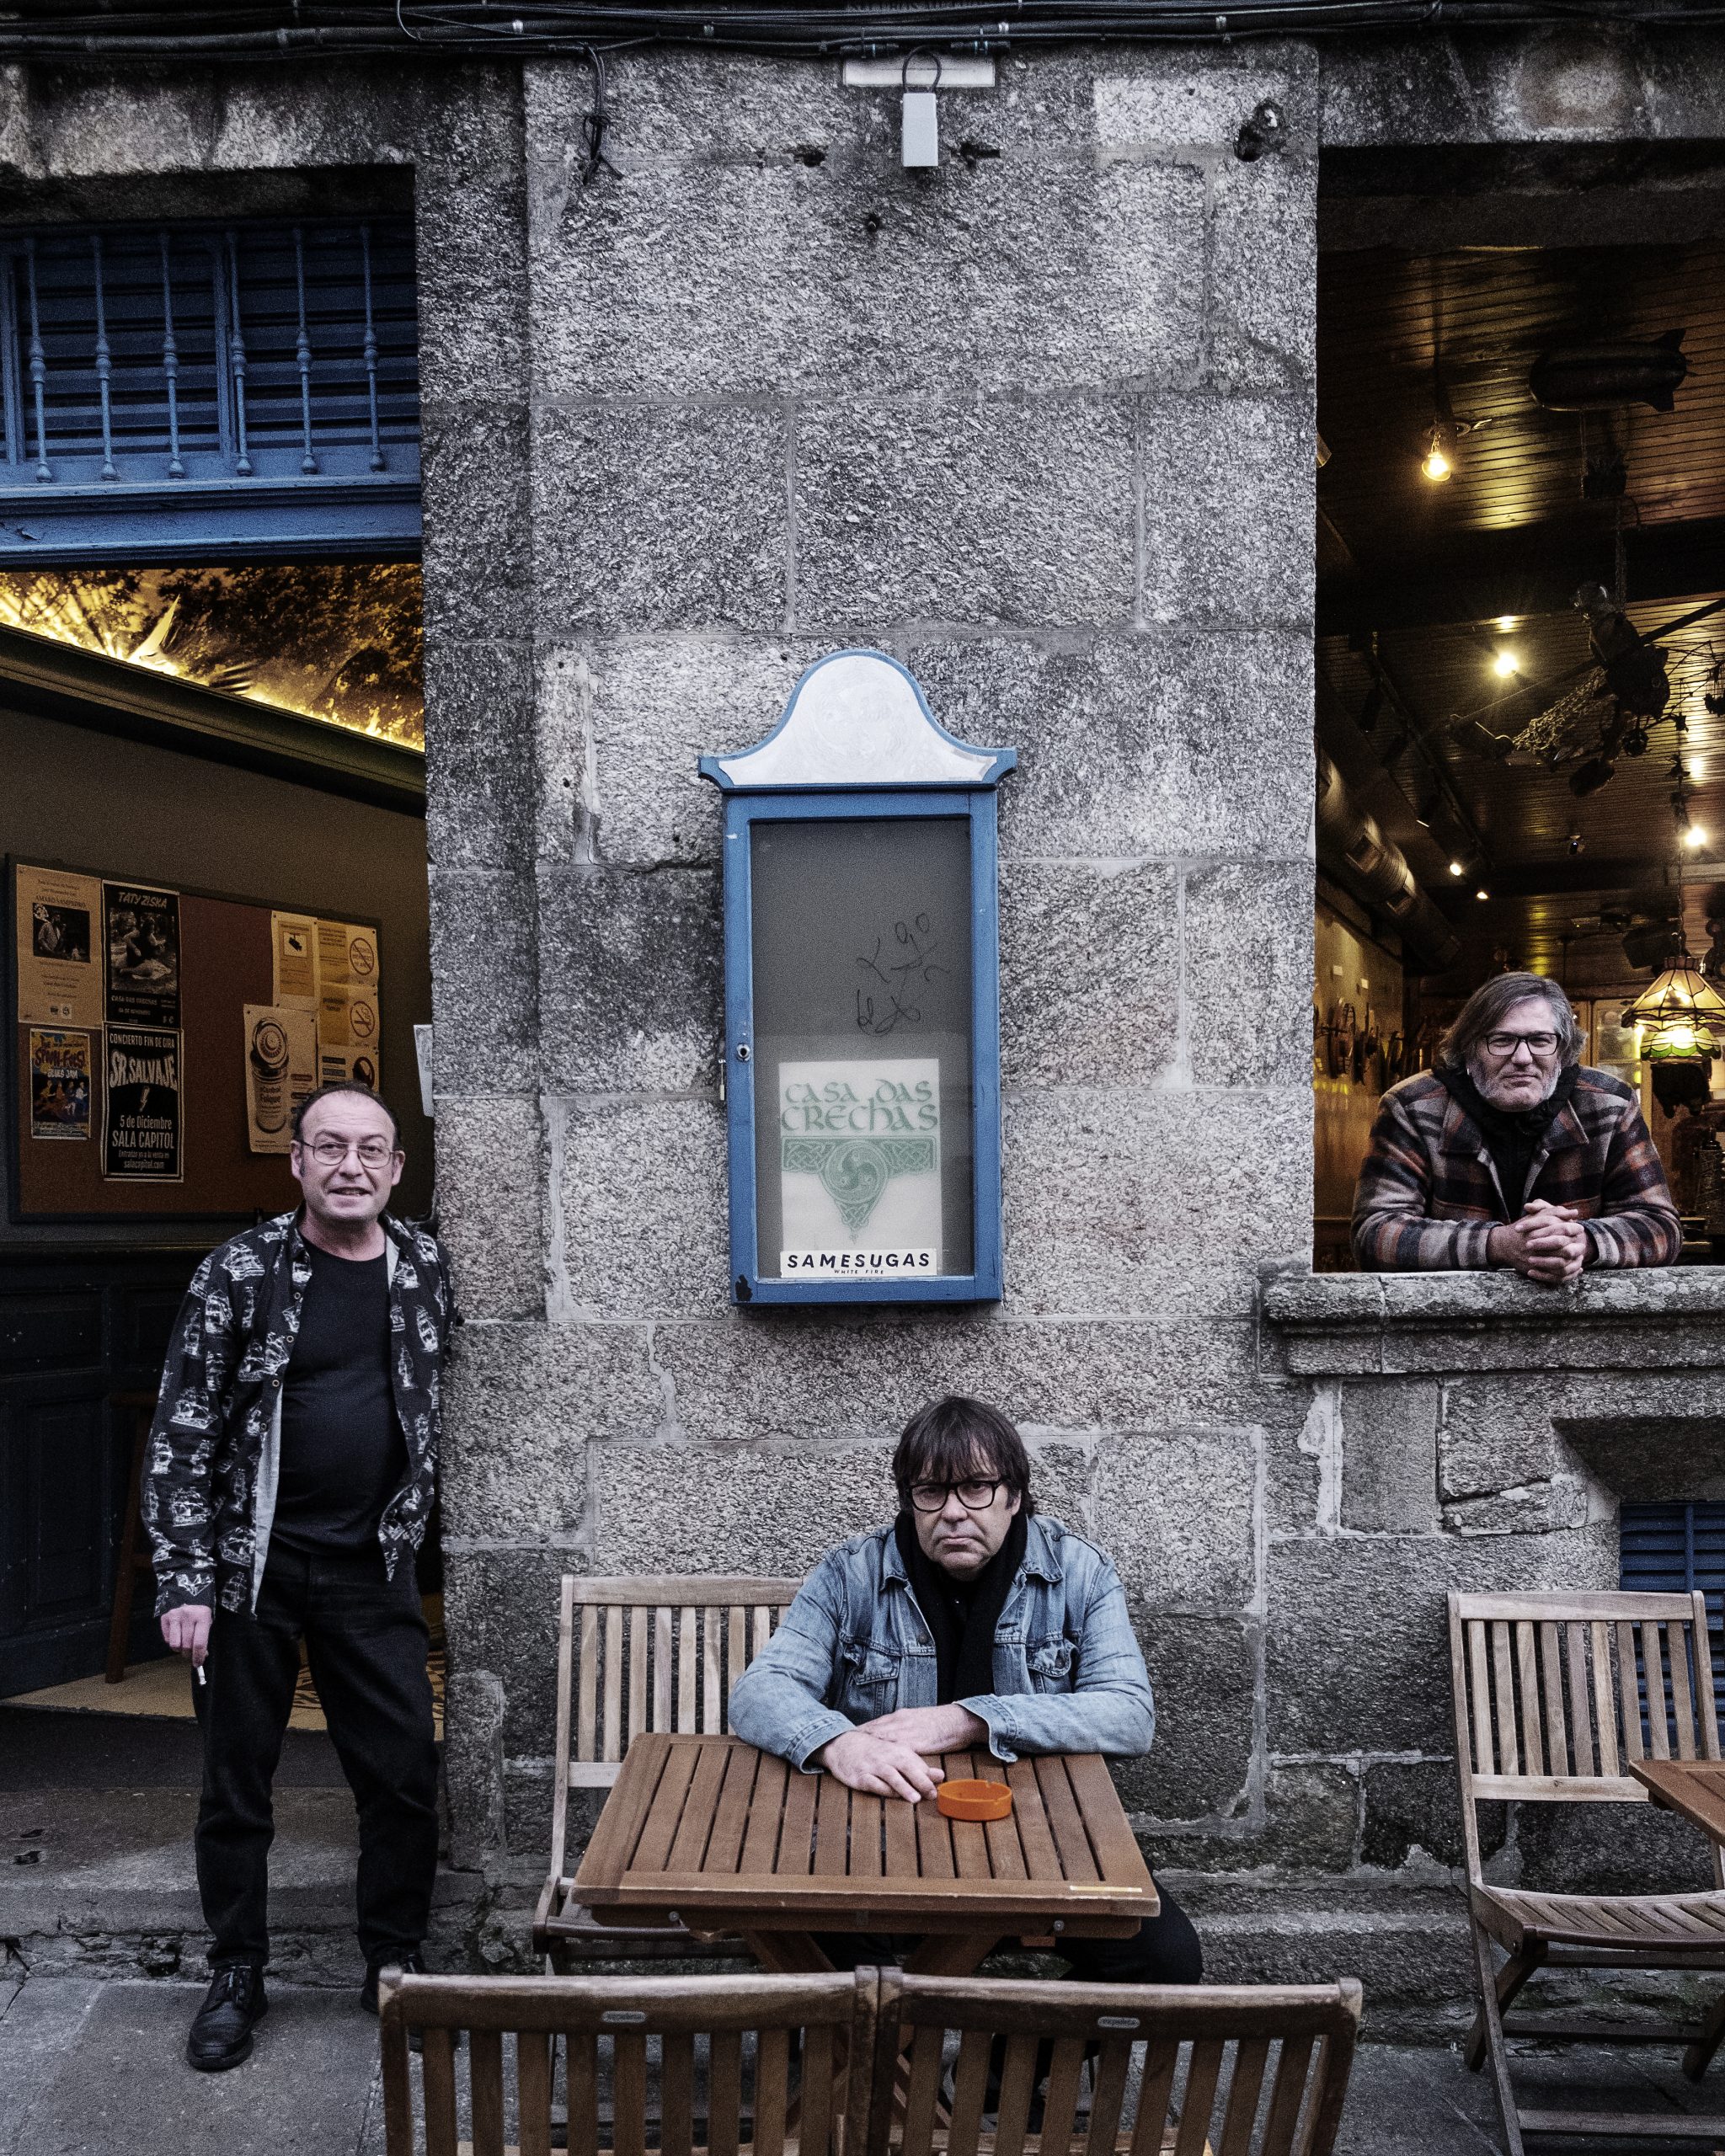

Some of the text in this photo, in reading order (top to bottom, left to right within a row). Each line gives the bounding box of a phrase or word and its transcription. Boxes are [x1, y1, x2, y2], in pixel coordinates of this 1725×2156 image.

[119, 891, 142, 905] TATY
[109, 1033, 175, 1049] CONCIERTO FIN DE GIRA
[785, 1078, 933, 1103] CASA DAS
[120, 1114, 173, 1129] 5 de Diciembre
[112, 1129, 174, 1149] SALA CAPITOL
[787, 1252, 930, 1269] SAMESUGAS
